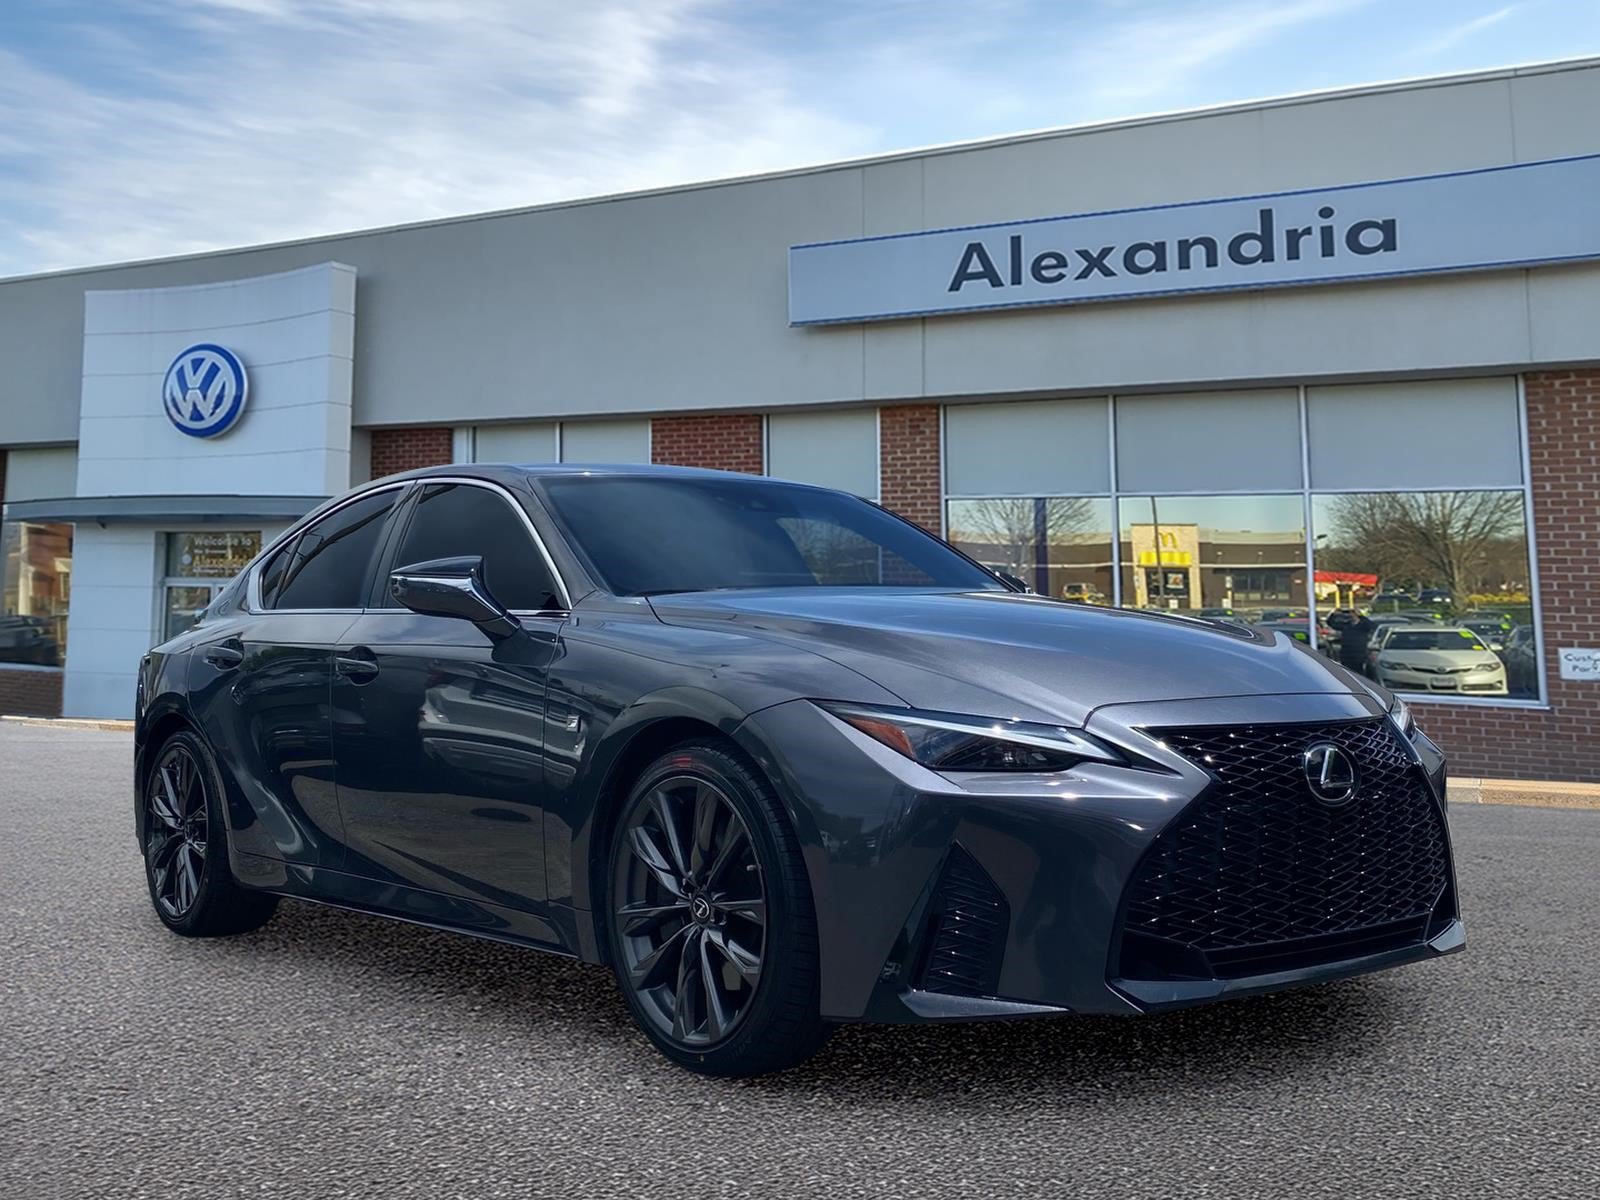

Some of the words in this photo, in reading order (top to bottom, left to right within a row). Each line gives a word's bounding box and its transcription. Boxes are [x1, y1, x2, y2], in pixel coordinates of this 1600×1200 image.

[947, 206, 1397, 292] Alexandria
[194, 536, 239, 546] Welcome
[241, 536, 252, 546] to
[193, 555, 250, 567] Alexandri
